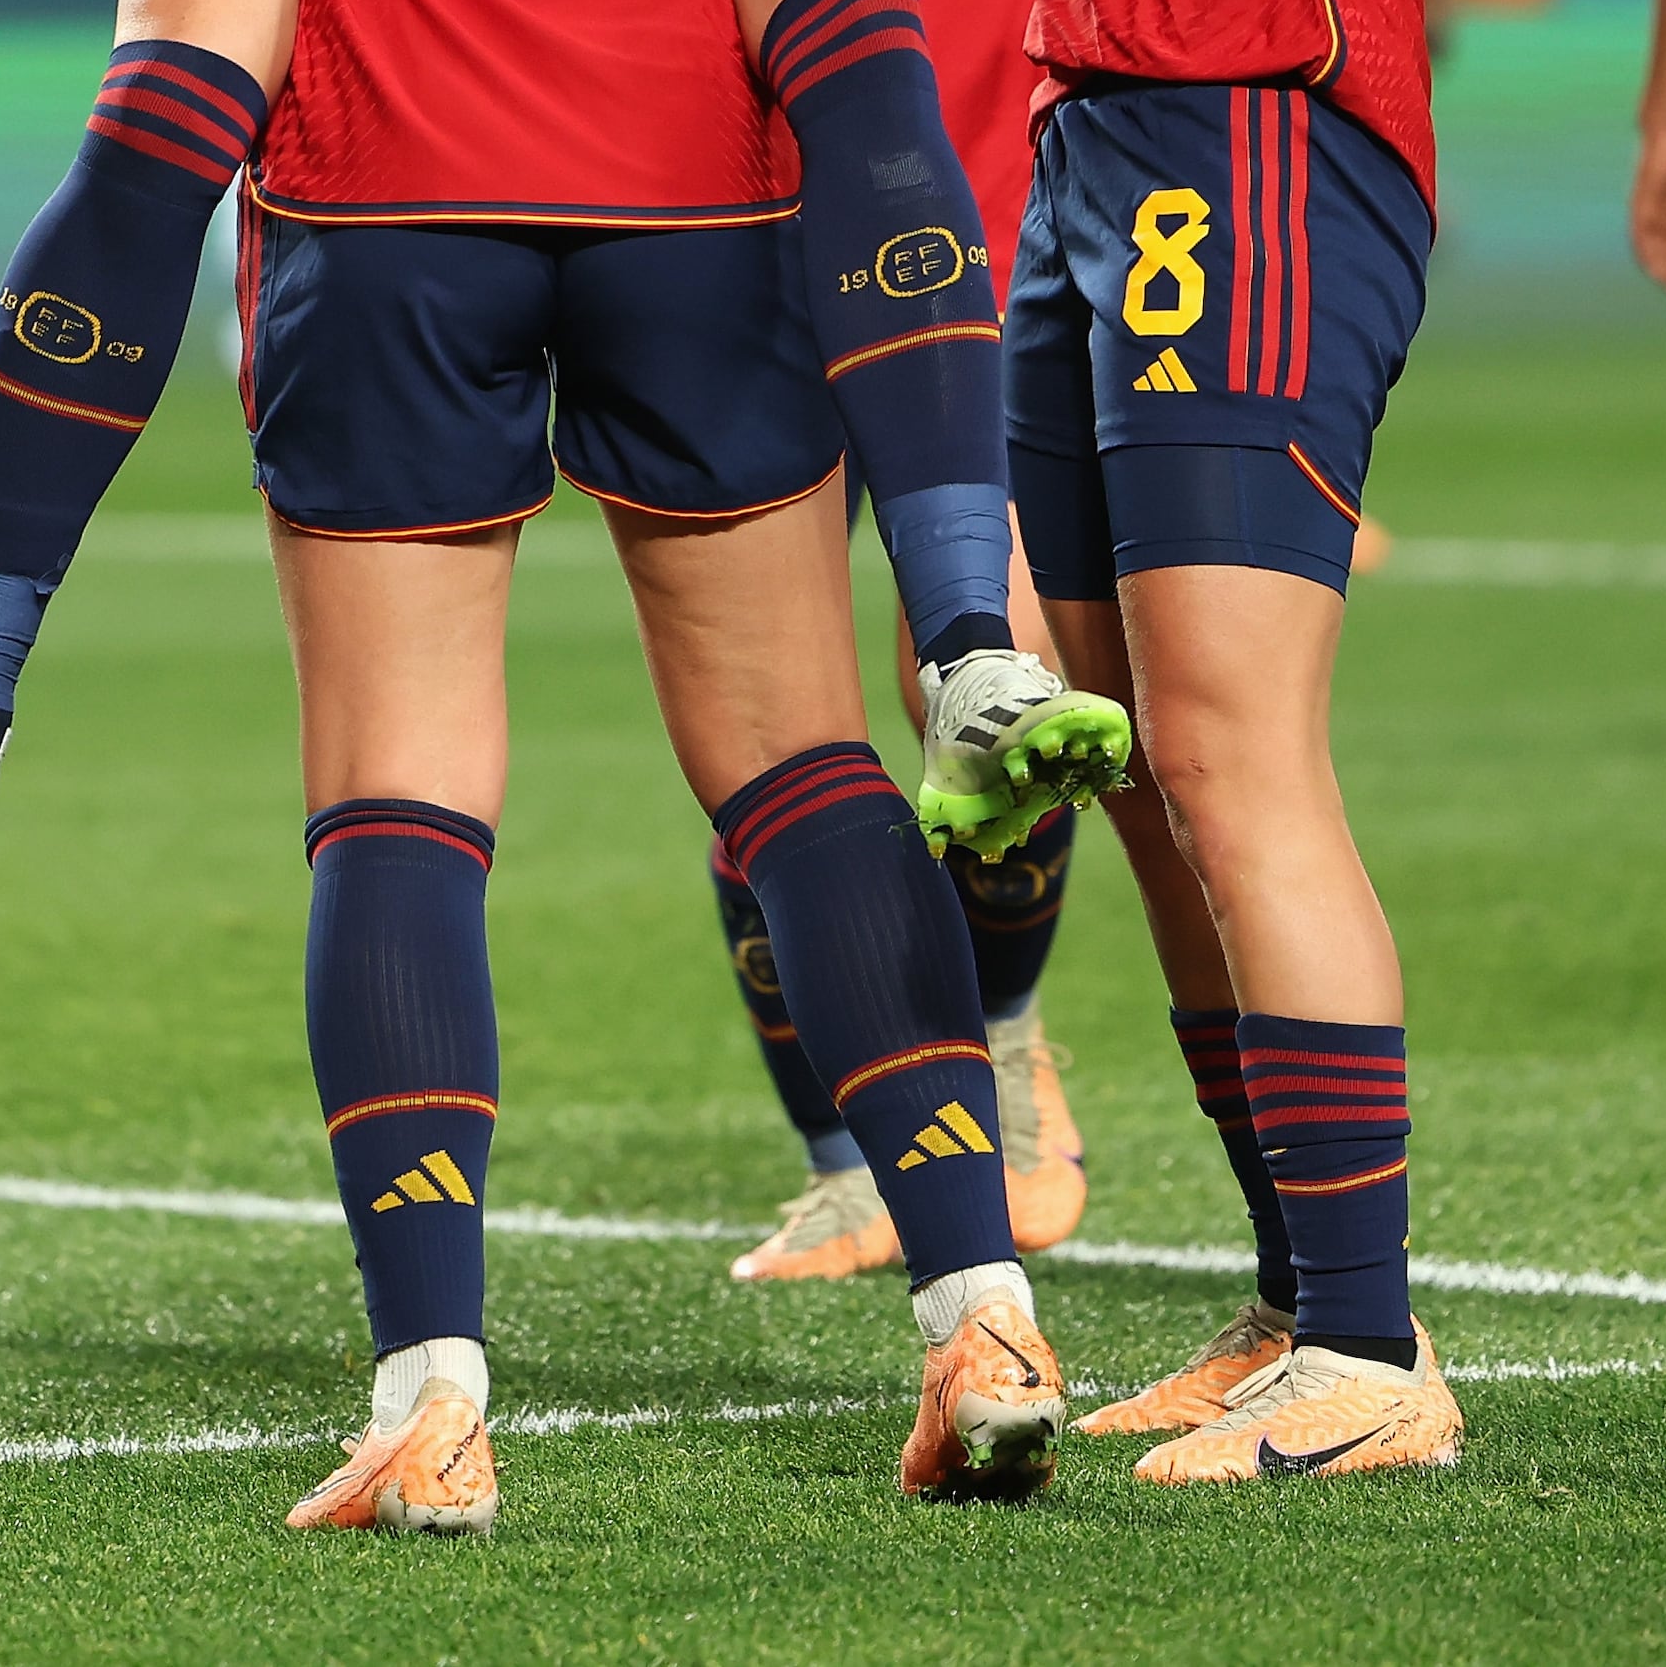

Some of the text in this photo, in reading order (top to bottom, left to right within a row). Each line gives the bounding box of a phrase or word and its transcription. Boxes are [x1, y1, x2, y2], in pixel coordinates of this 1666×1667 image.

[968, 245, 988, 268] 09
[1123, 188, 1211, 337] 8
[838, 269, 869, 294] 19
[106, 340, 145, 363] 09
